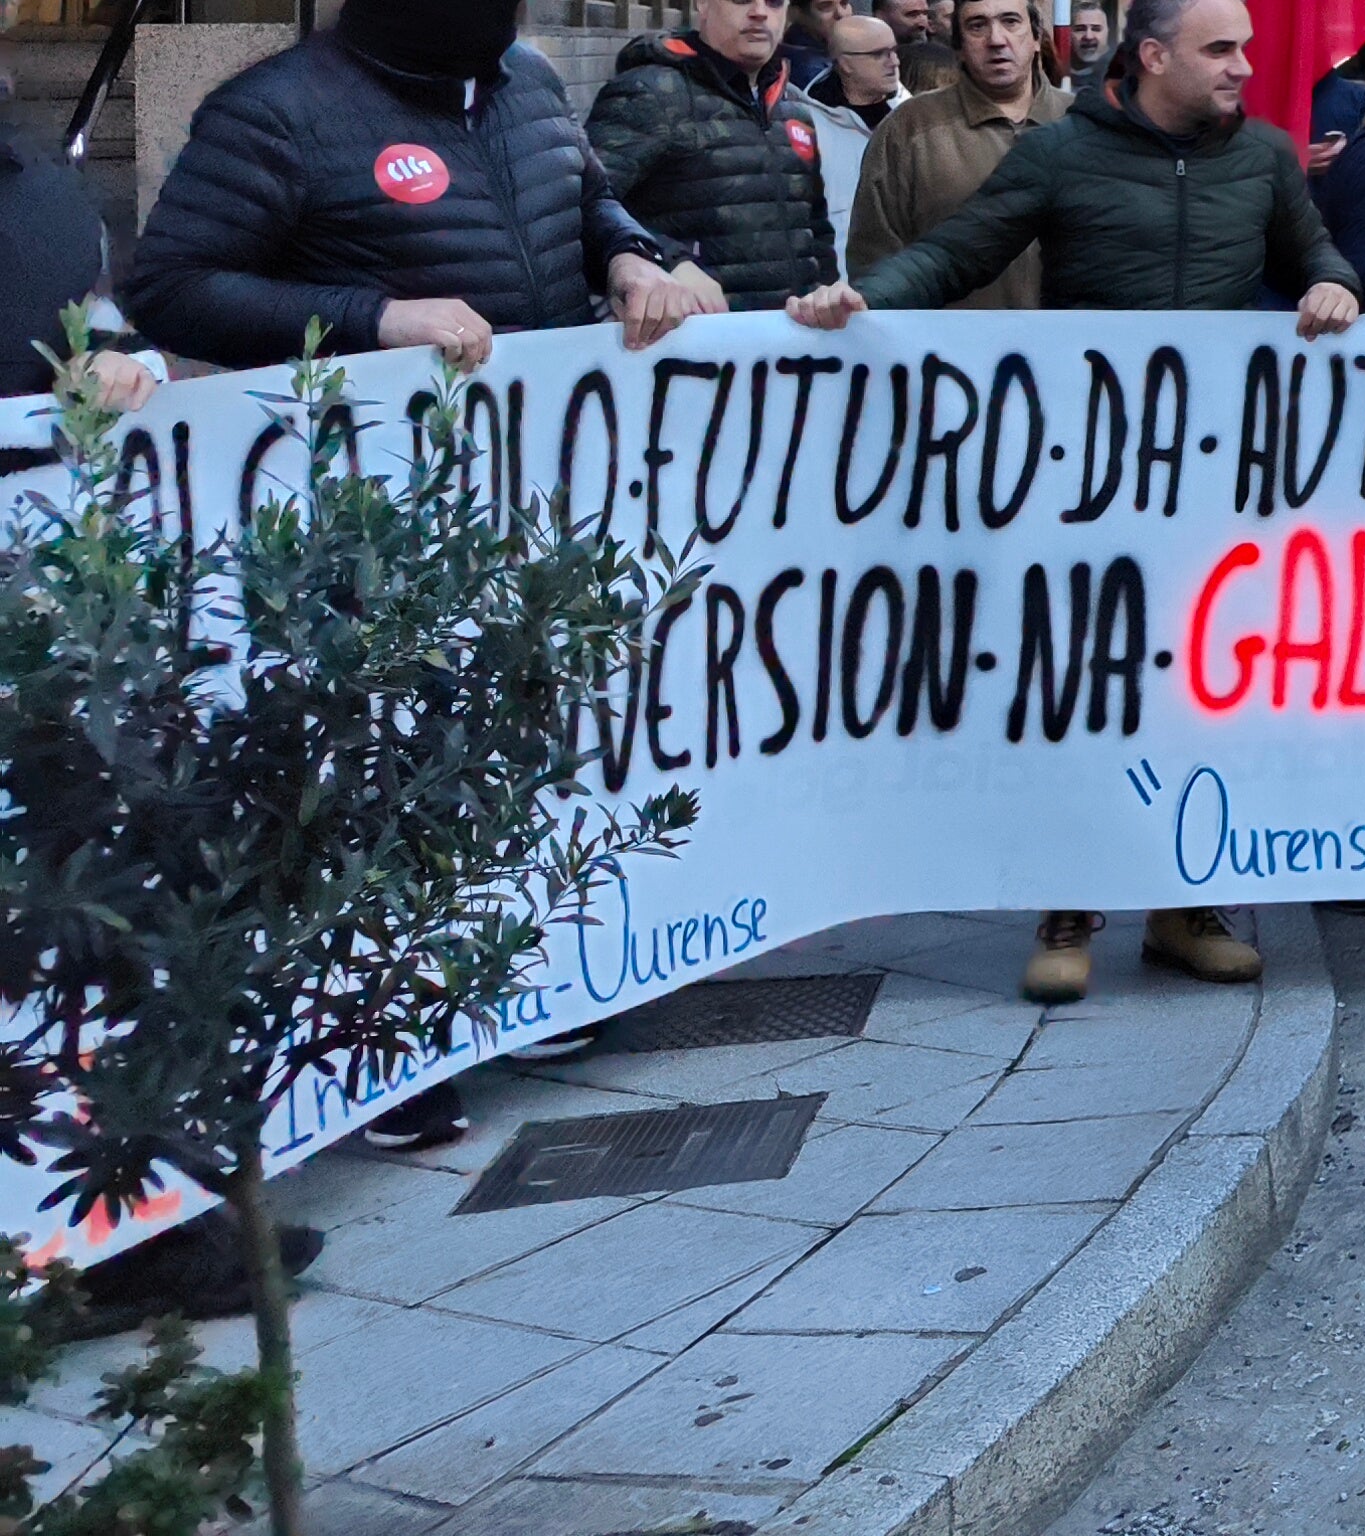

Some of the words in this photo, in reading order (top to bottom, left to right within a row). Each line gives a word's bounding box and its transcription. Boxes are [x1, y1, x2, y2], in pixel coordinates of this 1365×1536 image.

[645, 349, 1044, 558] FUTURO
[1062, 345, 1190, 522] DA
[1006, 555, 1147, 743] NA
